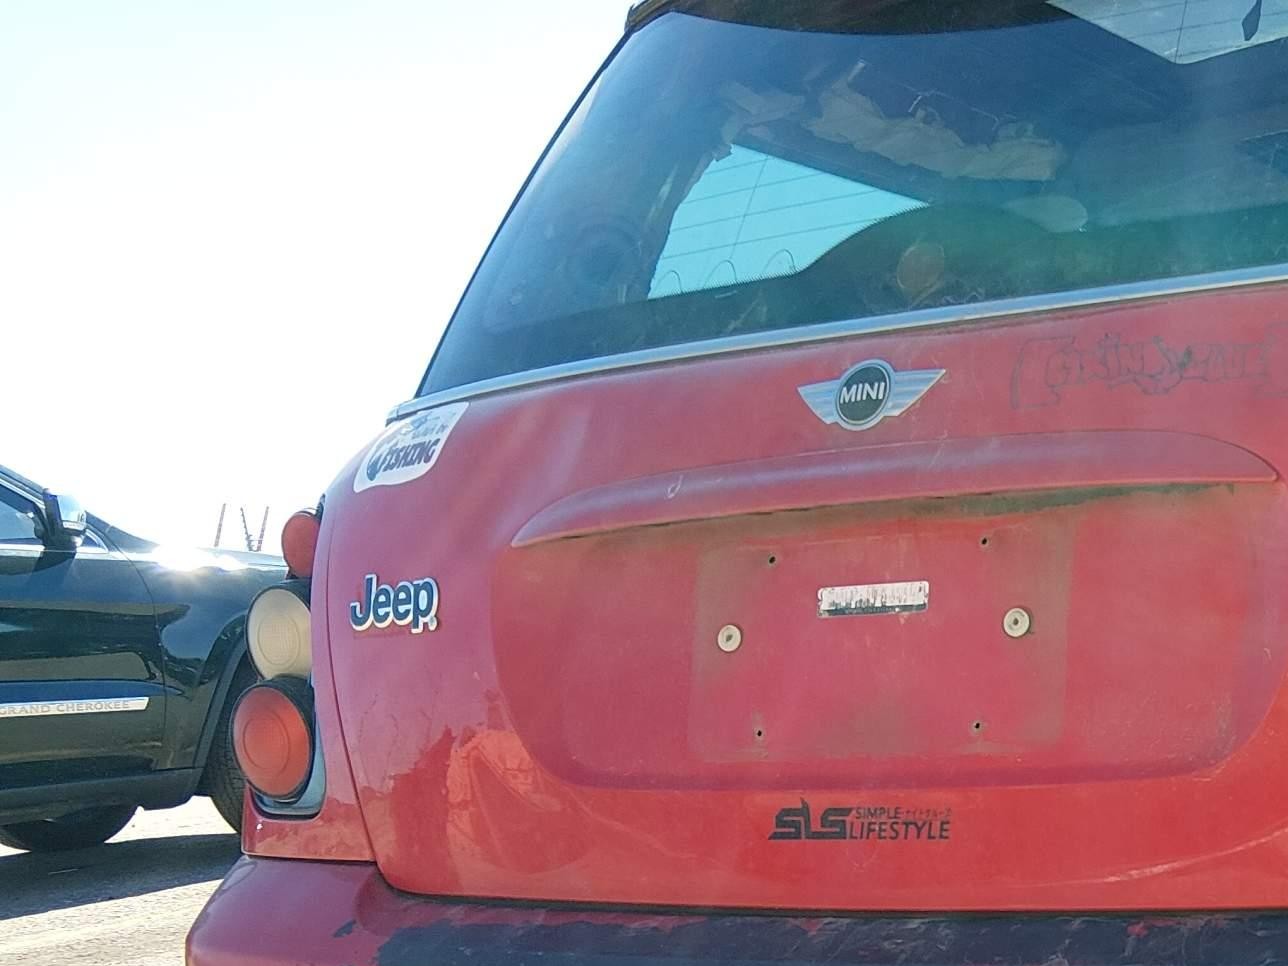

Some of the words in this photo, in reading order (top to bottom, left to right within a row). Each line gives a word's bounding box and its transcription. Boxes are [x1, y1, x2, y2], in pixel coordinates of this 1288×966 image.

[840, 382, 886, 404] MINI
[350, 574, 436, 631] Jeep
[0, 703, 50, 716] GRAND
[57, 700, 130, 713] CHEROKEE
[856, 806, 901, 820] SIMPLE
[850, 821, 951, 840] LIFESTYLE
